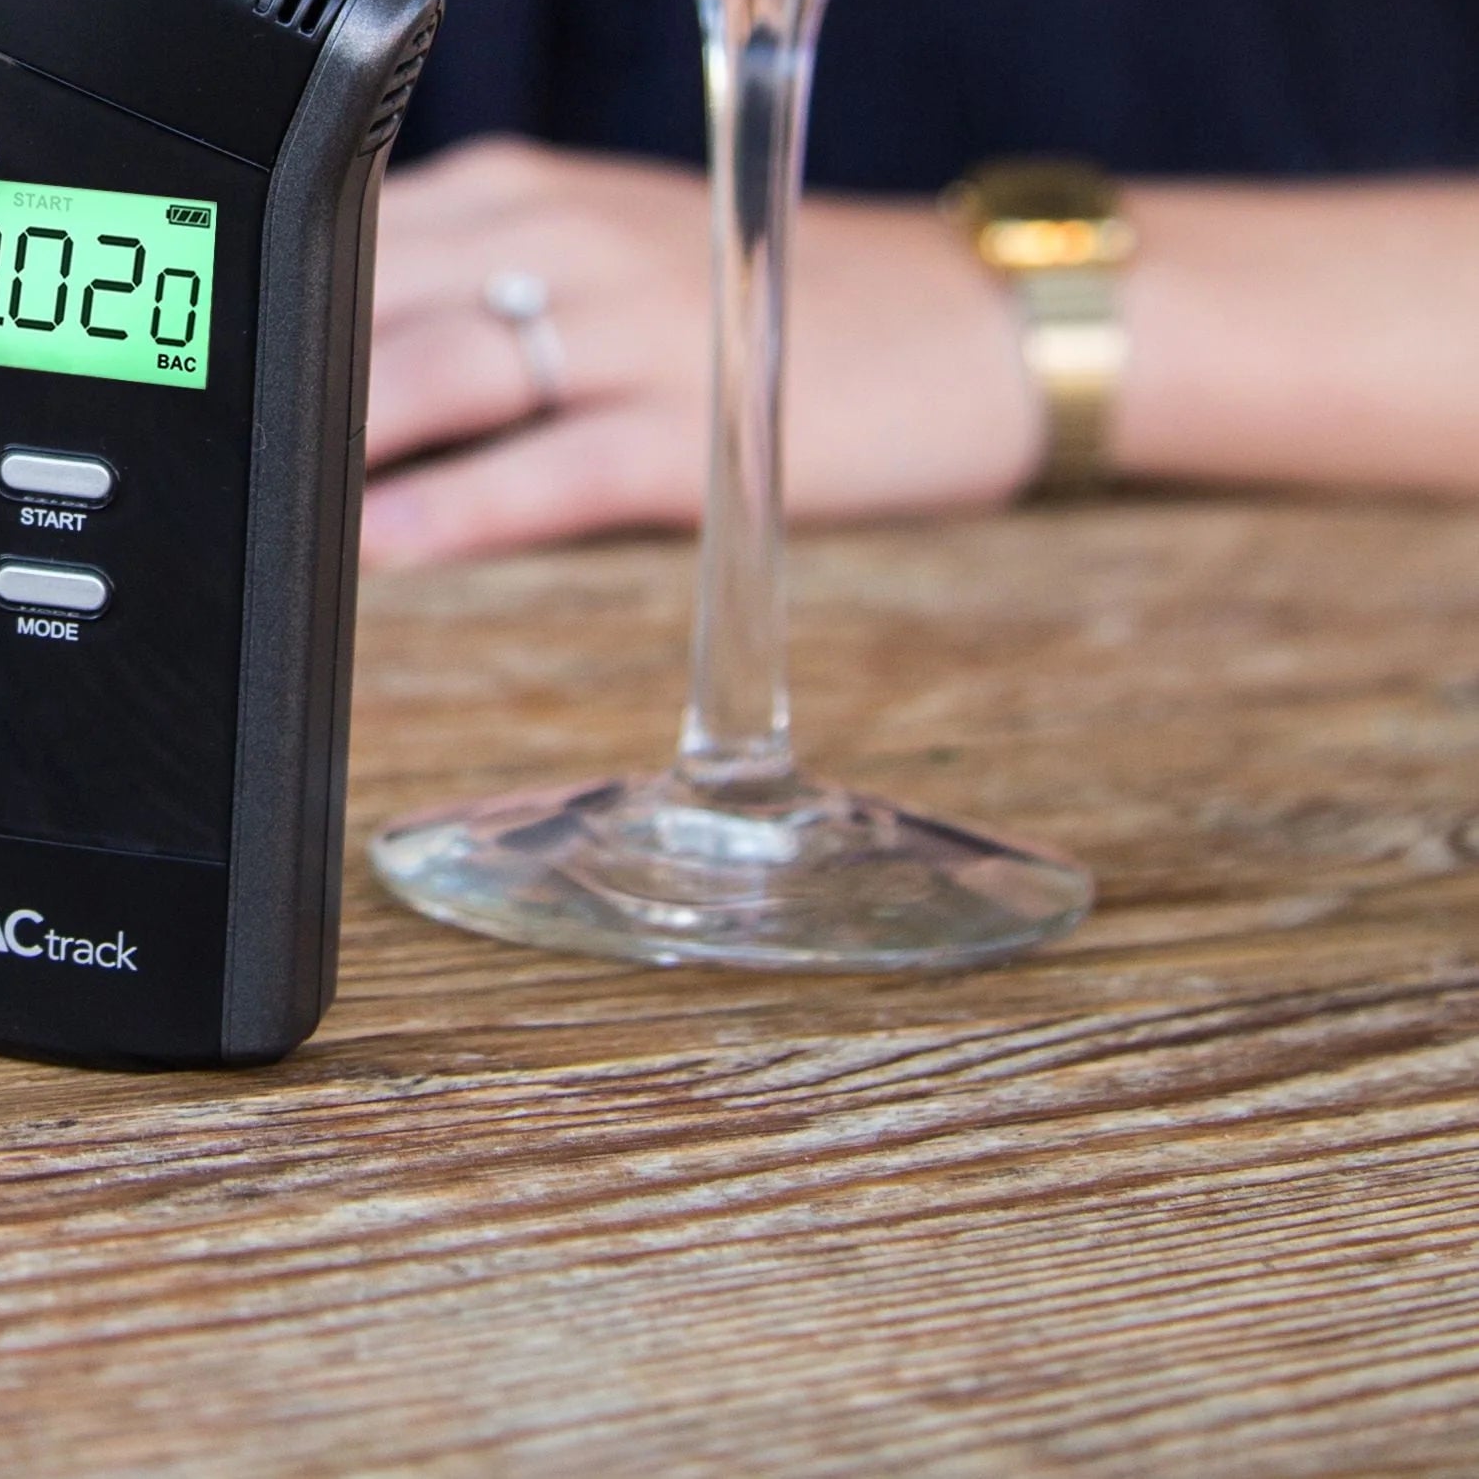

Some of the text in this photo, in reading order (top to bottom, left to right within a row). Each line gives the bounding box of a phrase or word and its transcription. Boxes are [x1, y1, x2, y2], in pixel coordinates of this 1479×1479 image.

[13, 192, 74, 212] START
[157, 353, 197, 372] BAC
[20, 507, 87, 531] START
[17, 617, 79, 641] MODE
